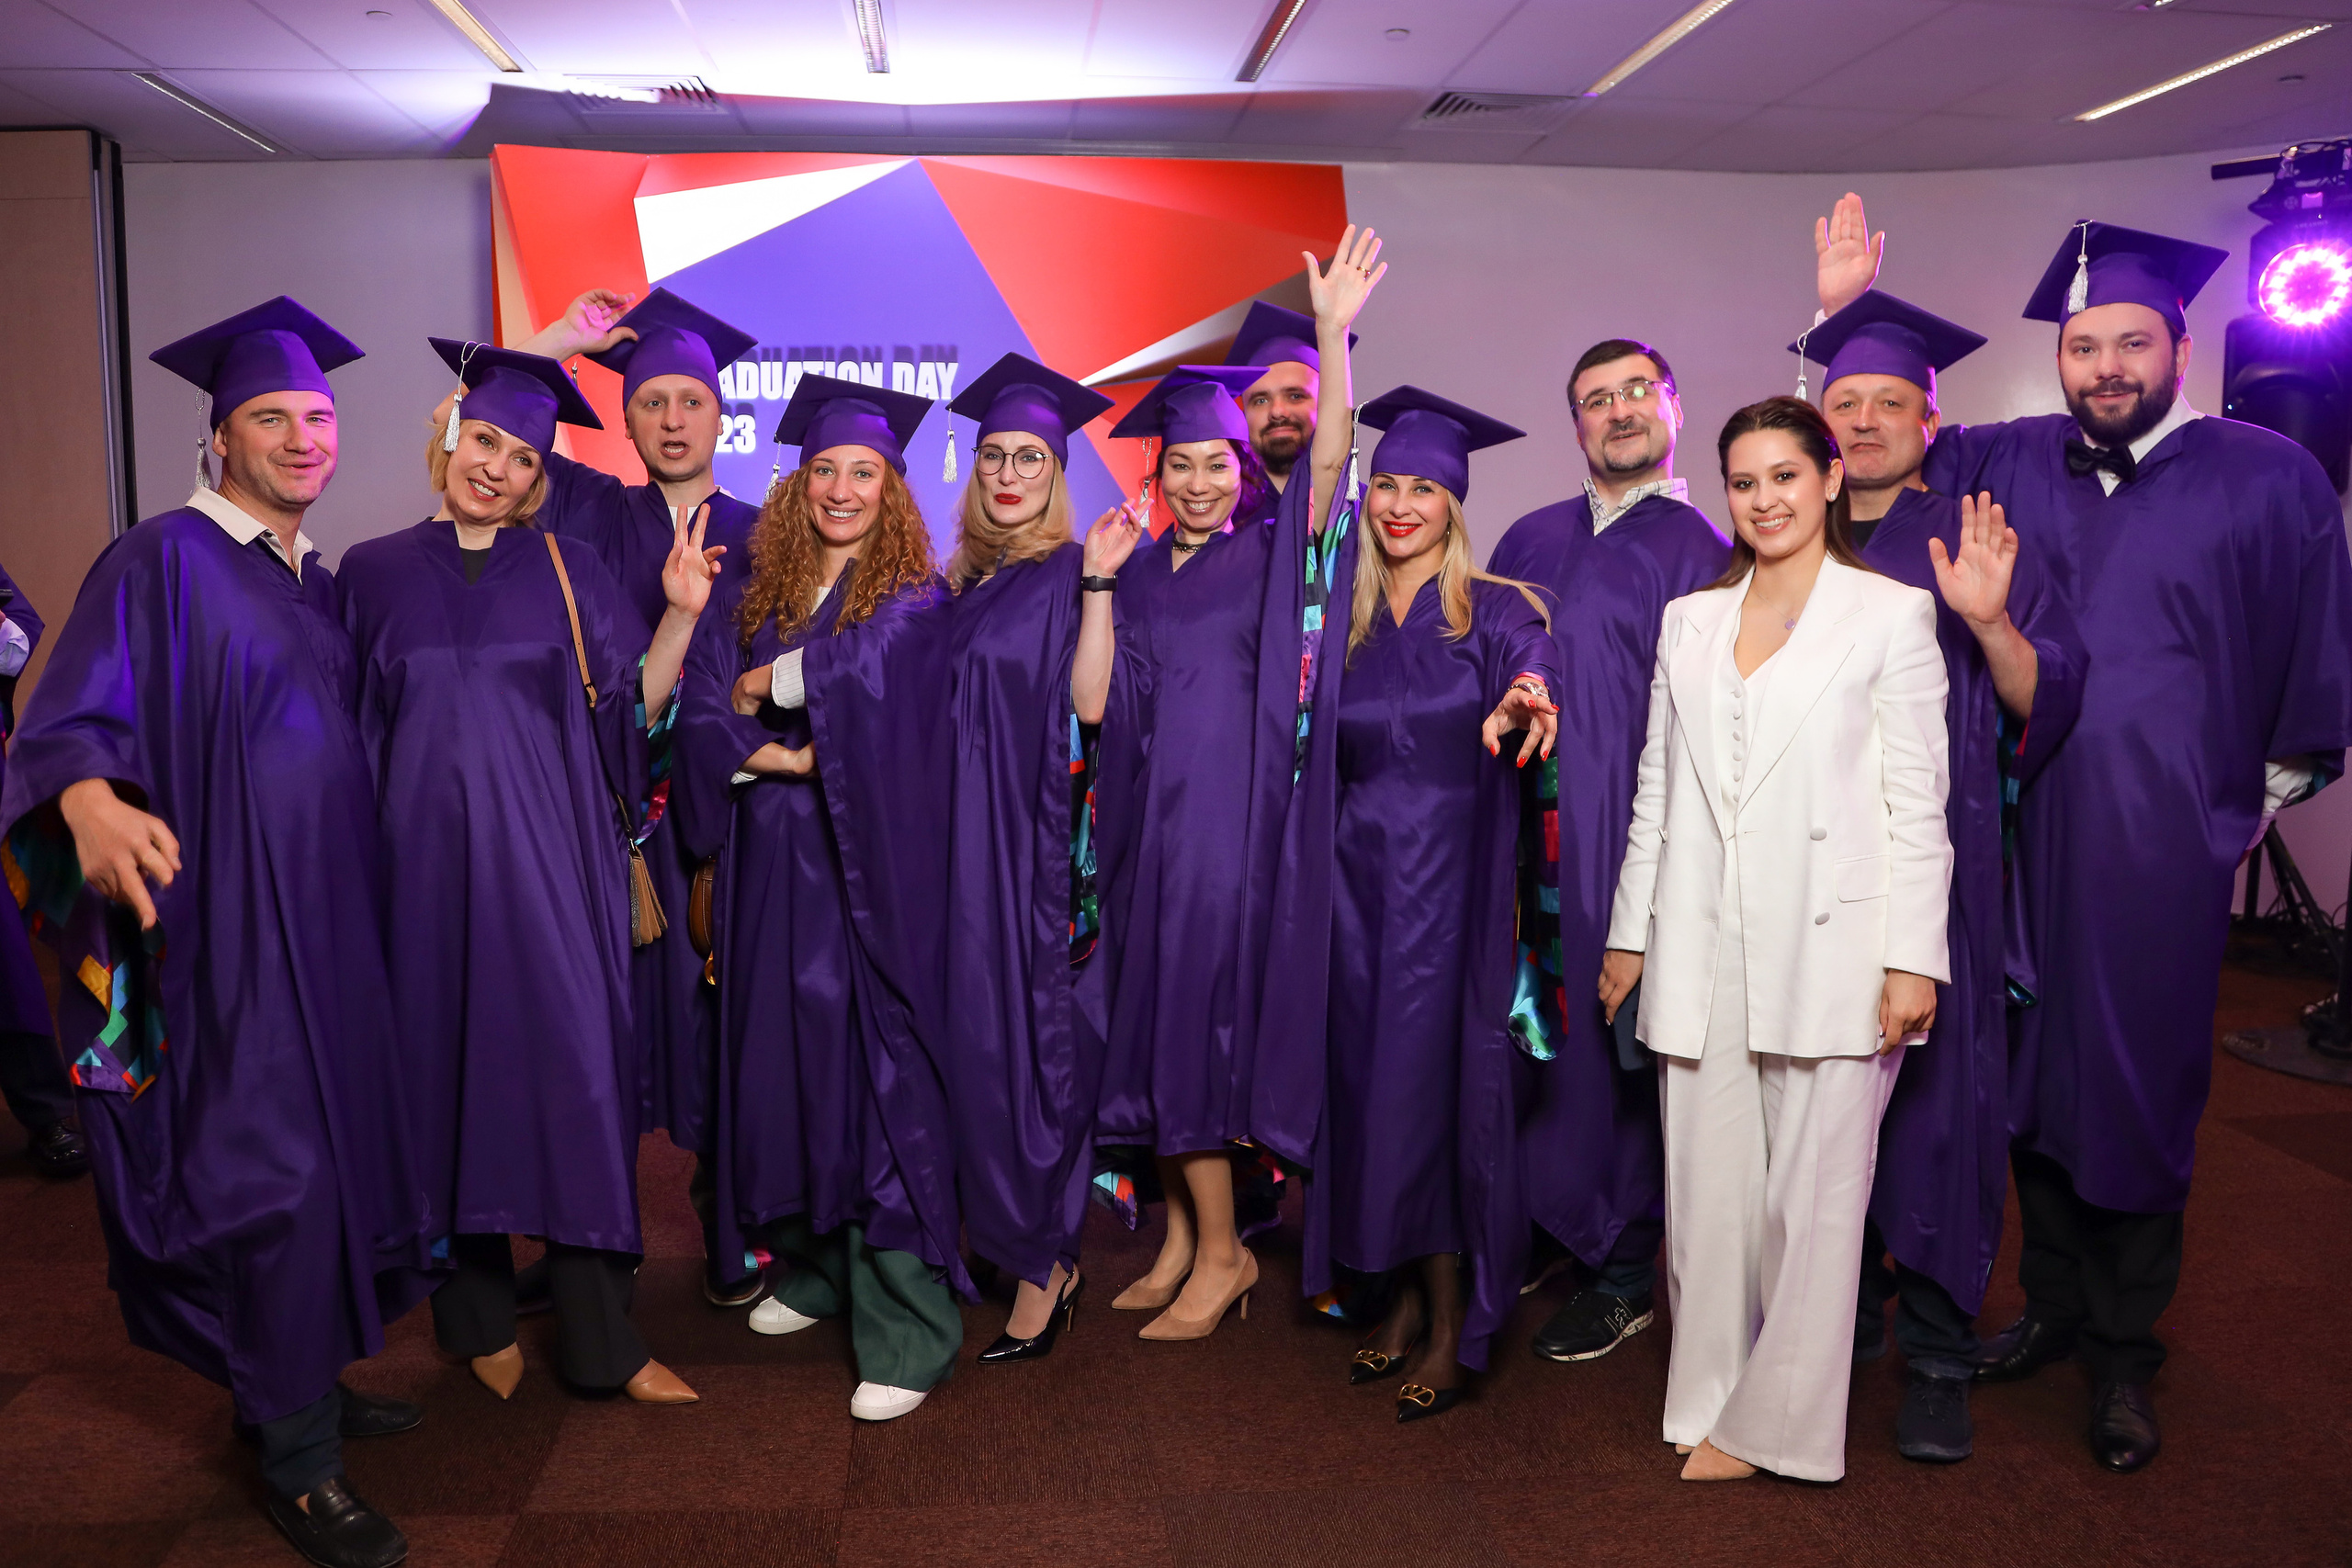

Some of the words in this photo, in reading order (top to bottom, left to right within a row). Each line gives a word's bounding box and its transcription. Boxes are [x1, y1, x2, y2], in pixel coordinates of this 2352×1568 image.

[718, 361, 884, 400] ADUAON
[892, 361, 959, 400] DAY
[715, 414, 756, 453] 23
